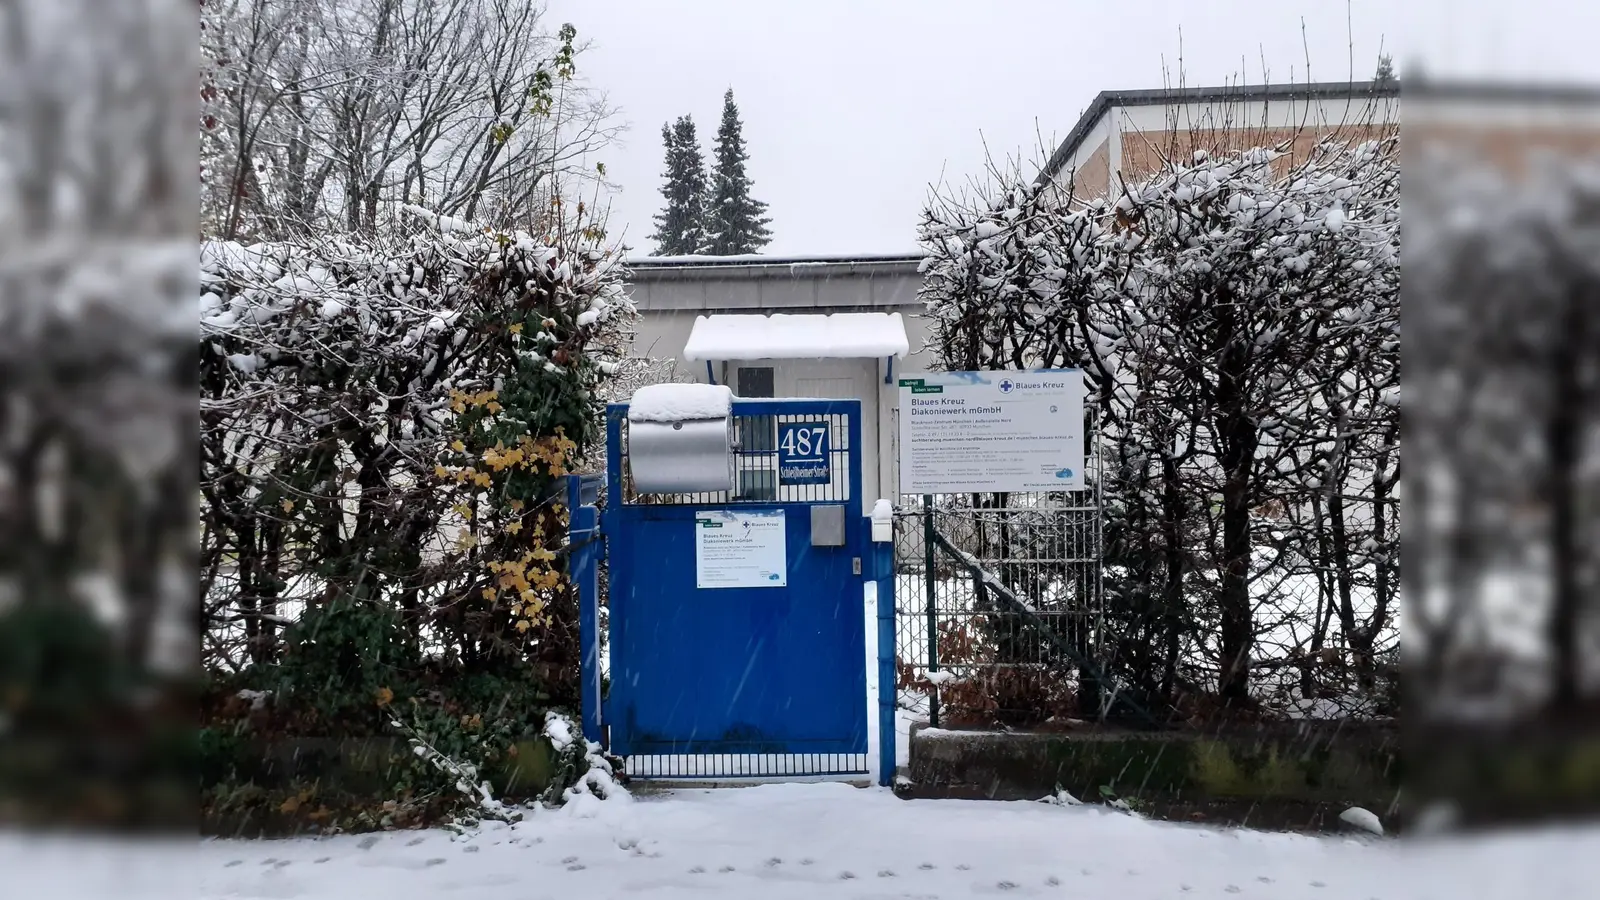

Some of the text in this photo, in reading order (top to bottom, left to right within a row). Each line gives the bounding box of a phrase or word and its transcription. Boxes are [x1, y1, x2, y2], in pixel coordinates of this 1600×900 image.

[1015, 380, 1065, 389] Blaues Kreuz
[911, 406, 1002, 416] Diakoniewerk mGmbH
[780, 427, 826, 456] 487
[780, 466, 814, 480] Schleißheimer
